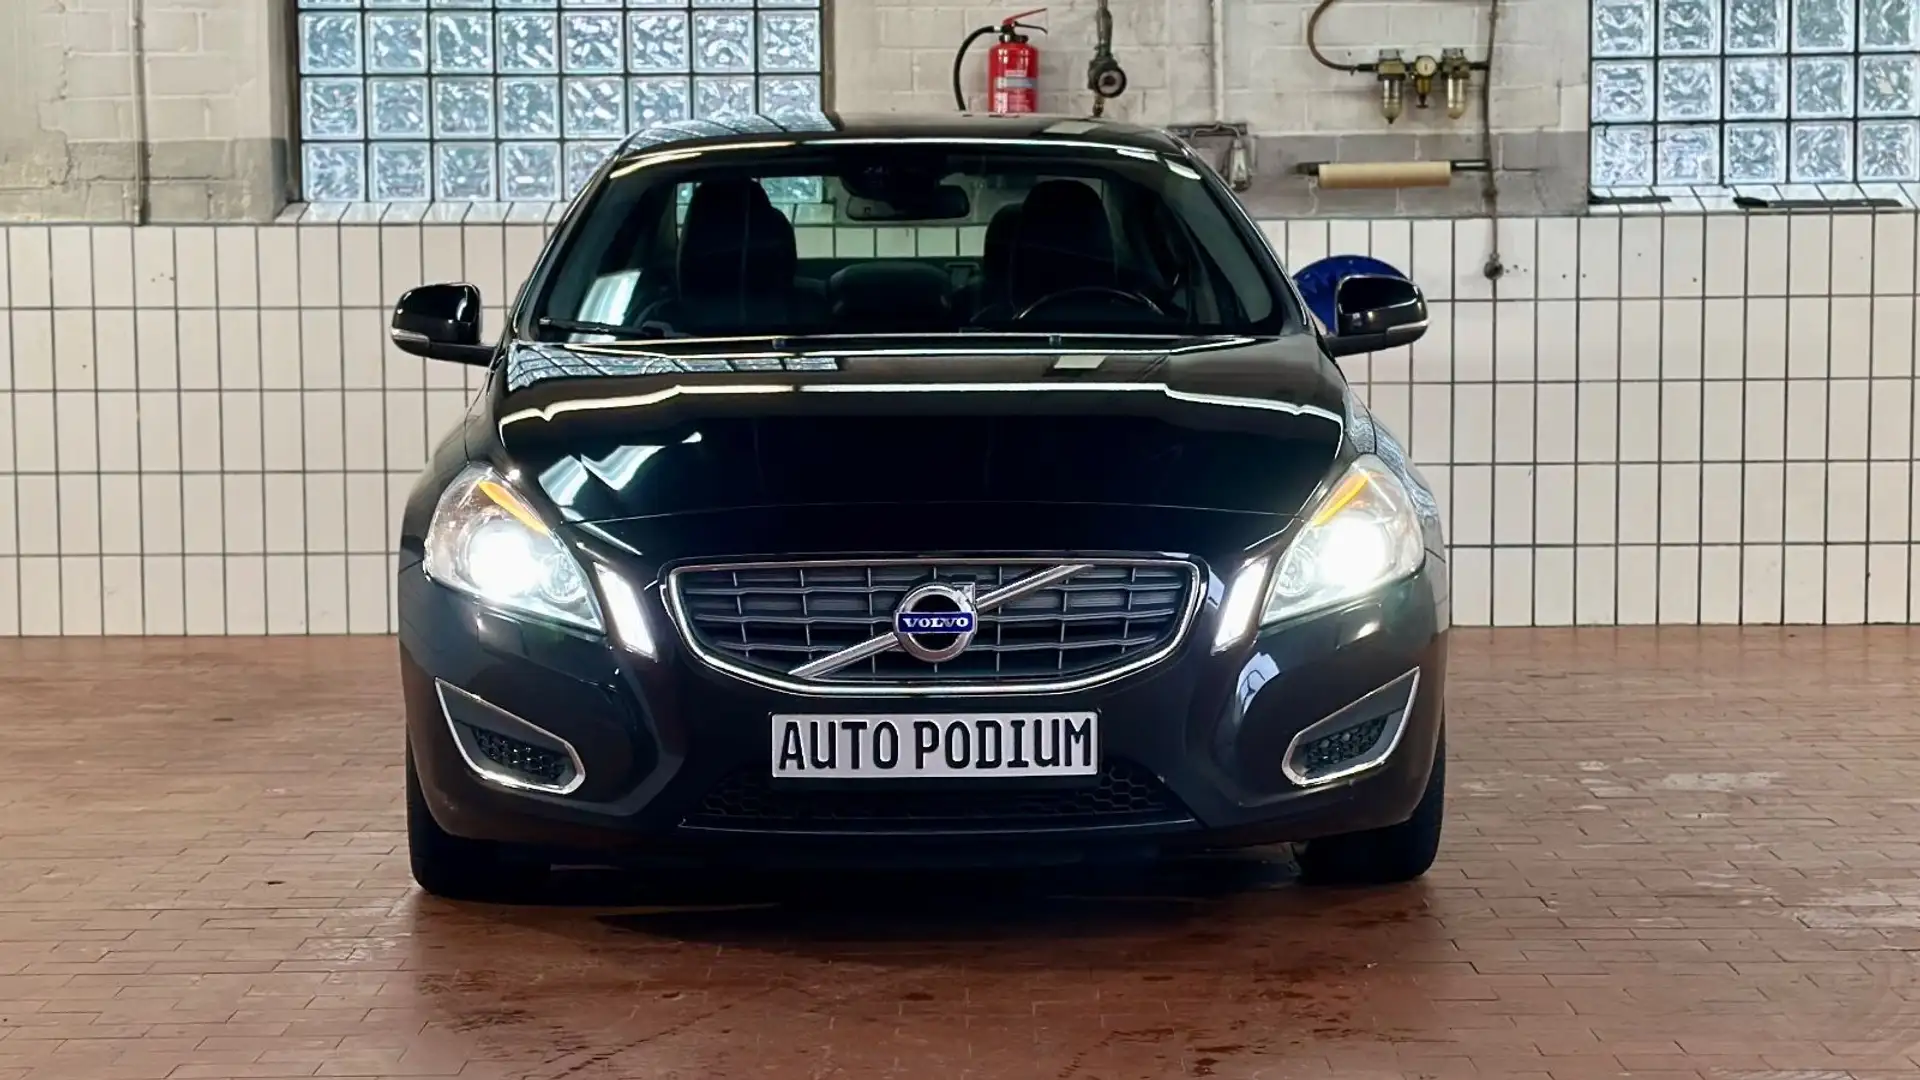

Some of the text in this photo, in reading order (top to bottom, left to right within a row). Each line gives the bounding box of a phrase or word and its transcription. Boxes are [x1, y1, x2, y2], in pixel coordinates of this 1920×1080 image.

[903, 617, 969, 628] VOLVO
[778, 718, 1091, 770] AUTO PODIUM
